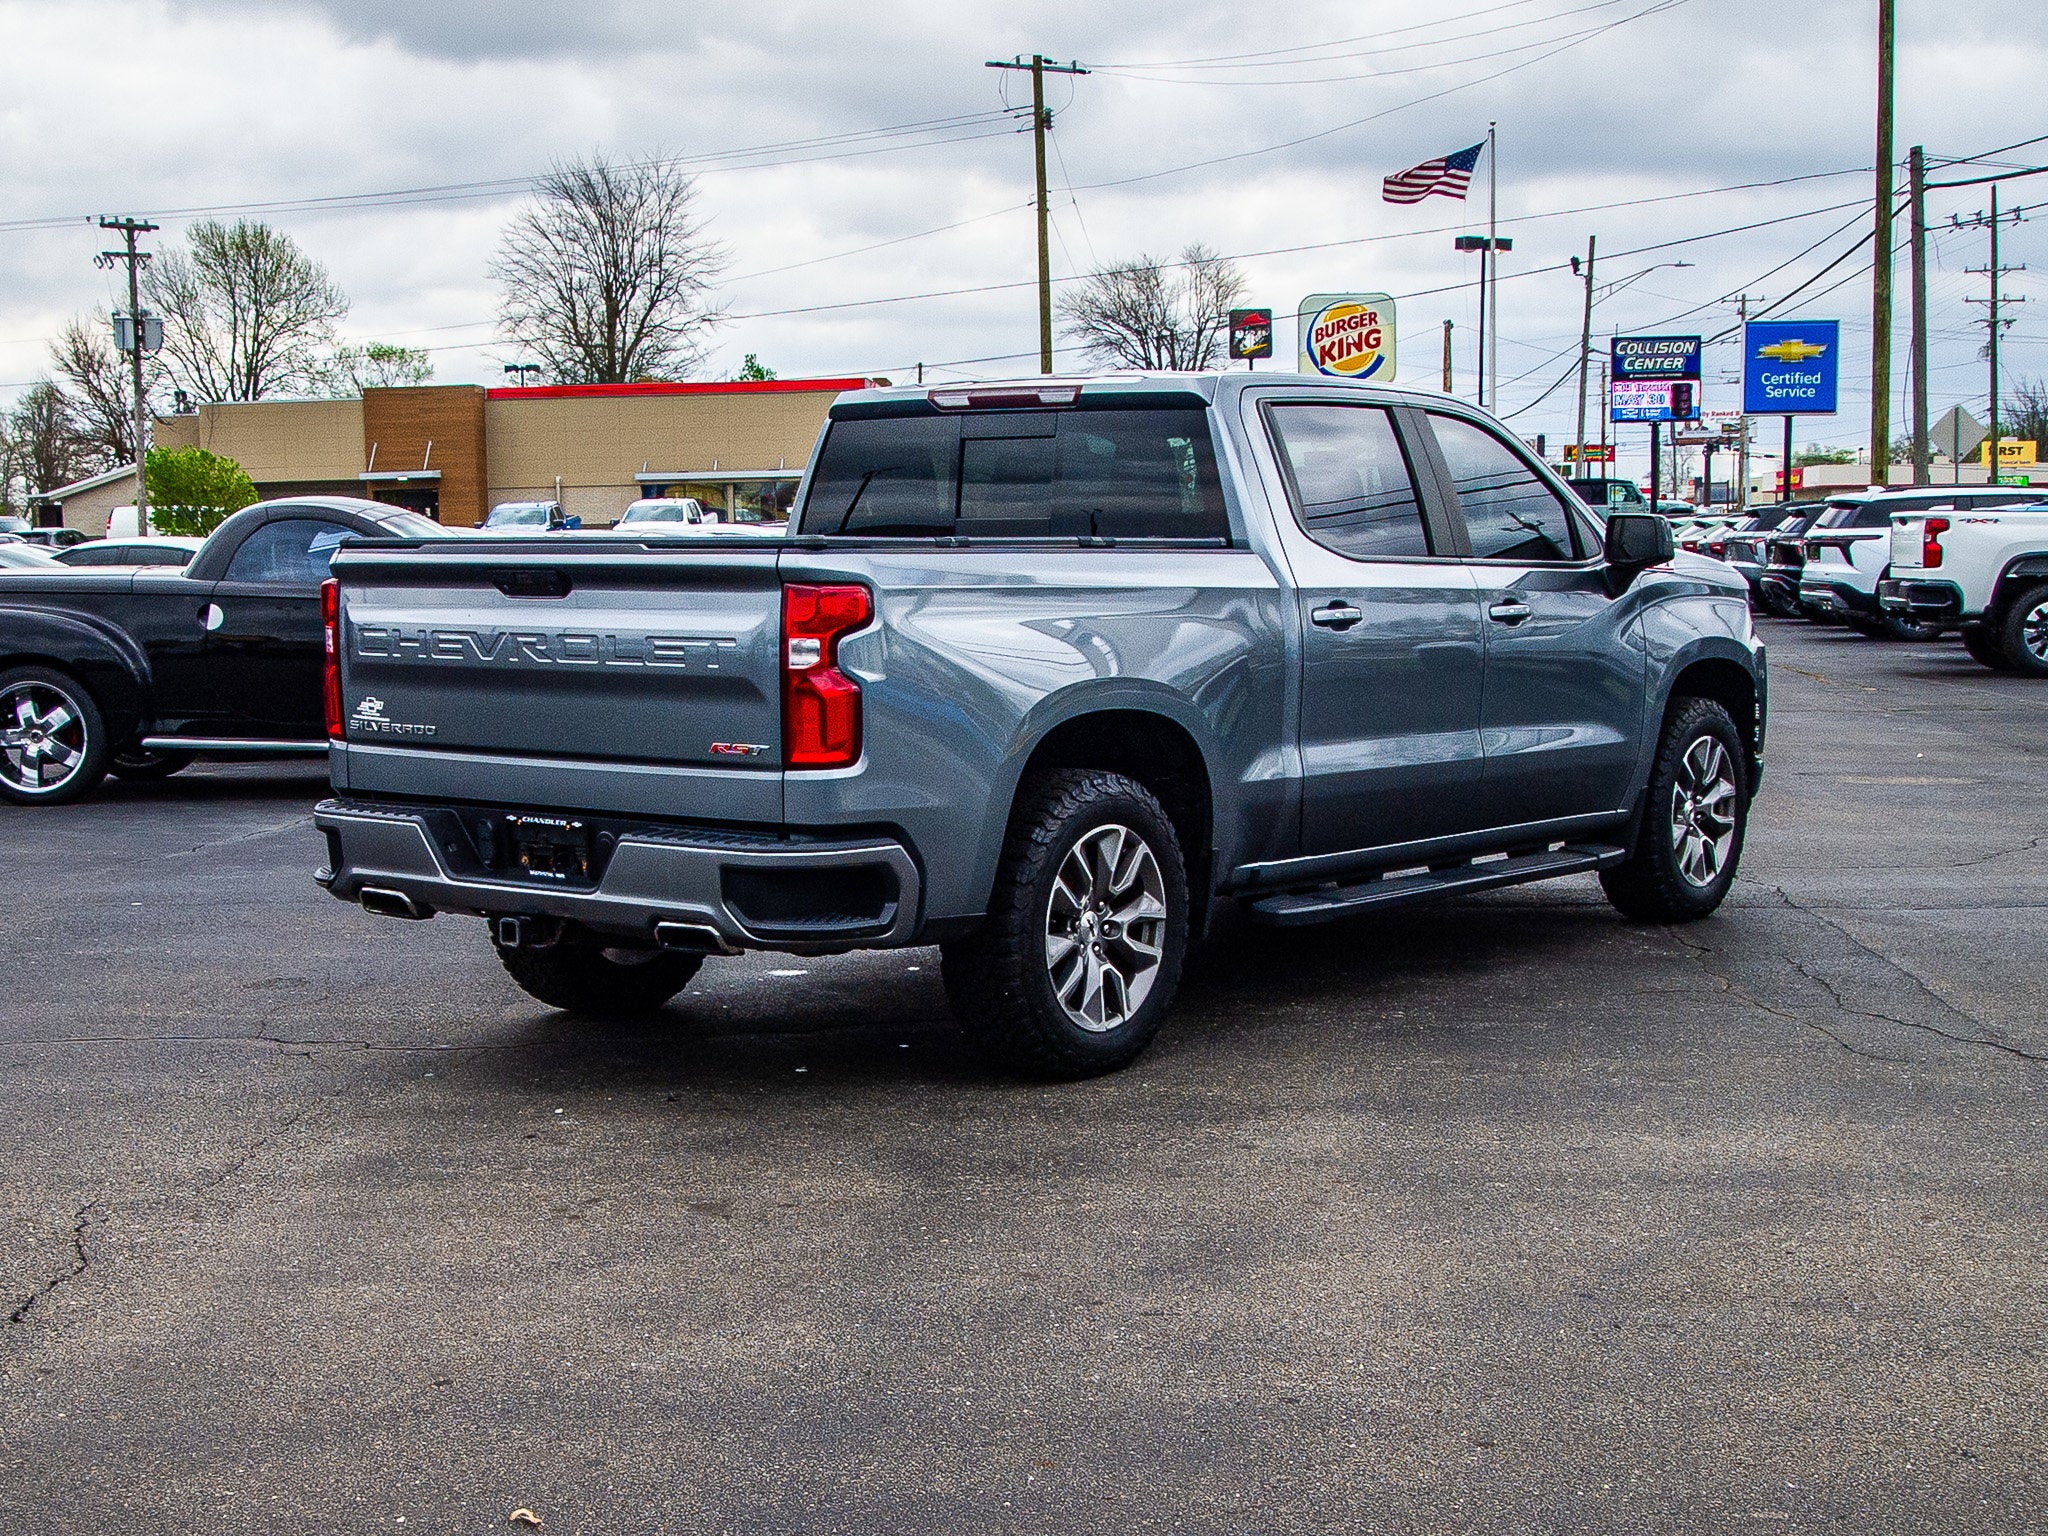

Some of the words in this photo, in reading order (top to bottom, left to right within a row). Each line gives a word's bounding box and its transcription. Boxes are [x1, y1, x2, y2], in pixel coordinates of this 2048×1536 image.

[1315, 311, 1378, 344] BURGER
[1319, 328, 1382, 367] KING
[1616, 341, 1696, 354] COLLISION
[1624, 356, 1684, 369] CENTER
[1761, 372, 1822, 385] Certified
[1765, 386, 1816, 398] Service
[1614, 393, 1645, 406] MAY
[1988, 446, 2024, 456] RST
[358, 628, 737, 669] CHEVROLET
[349, 719, 437, 735] SILVERADO
[709, 742, 770, 756] RST
[521, 816, 567, 827] CHANDLER
